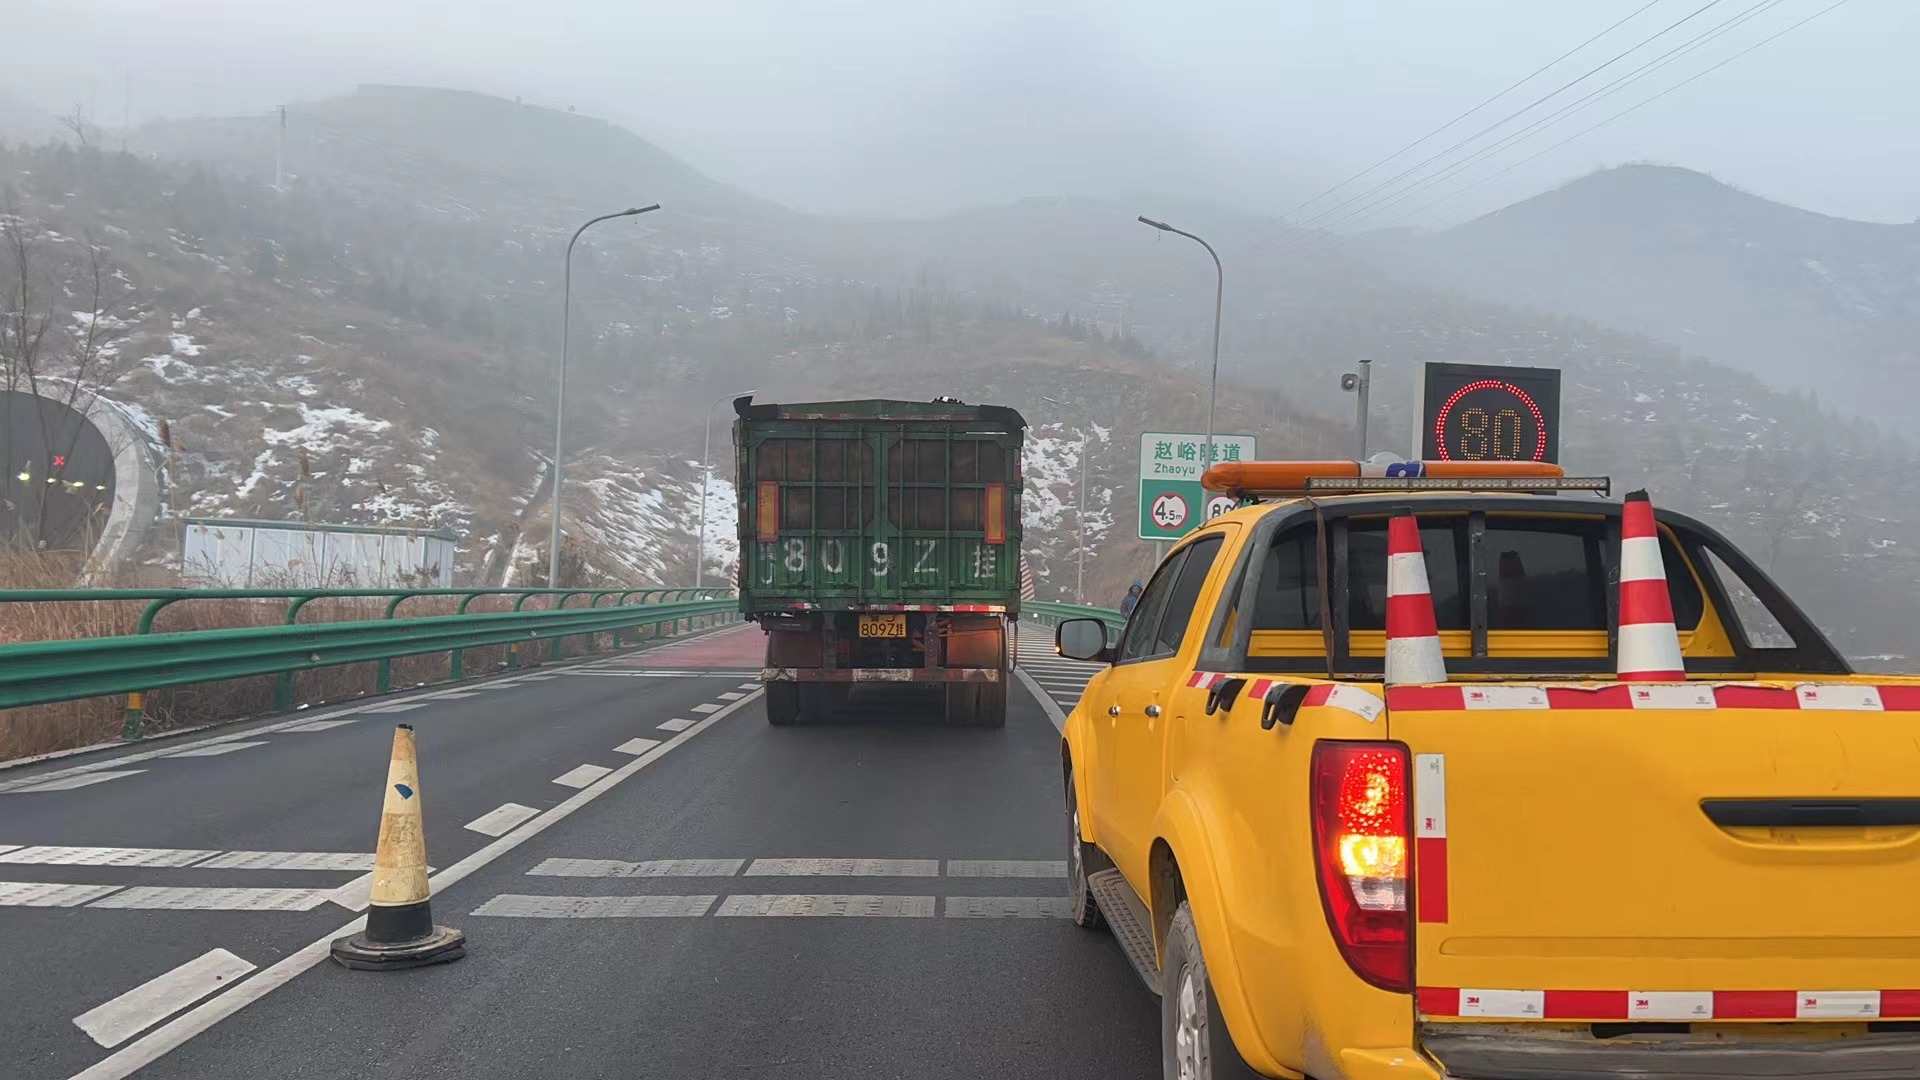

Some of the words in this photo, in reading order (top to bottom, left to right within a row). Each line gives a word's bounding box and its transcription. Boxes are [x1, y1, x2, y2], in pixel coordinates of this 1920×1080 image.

[1461, 407, 1521, 460] 80
[1154, 441, 1241, 461] 赵峪隧道
[1154, 463, 1195, 476] Zhaoyu
[1155, 501, 1183, 520] 4.5m
